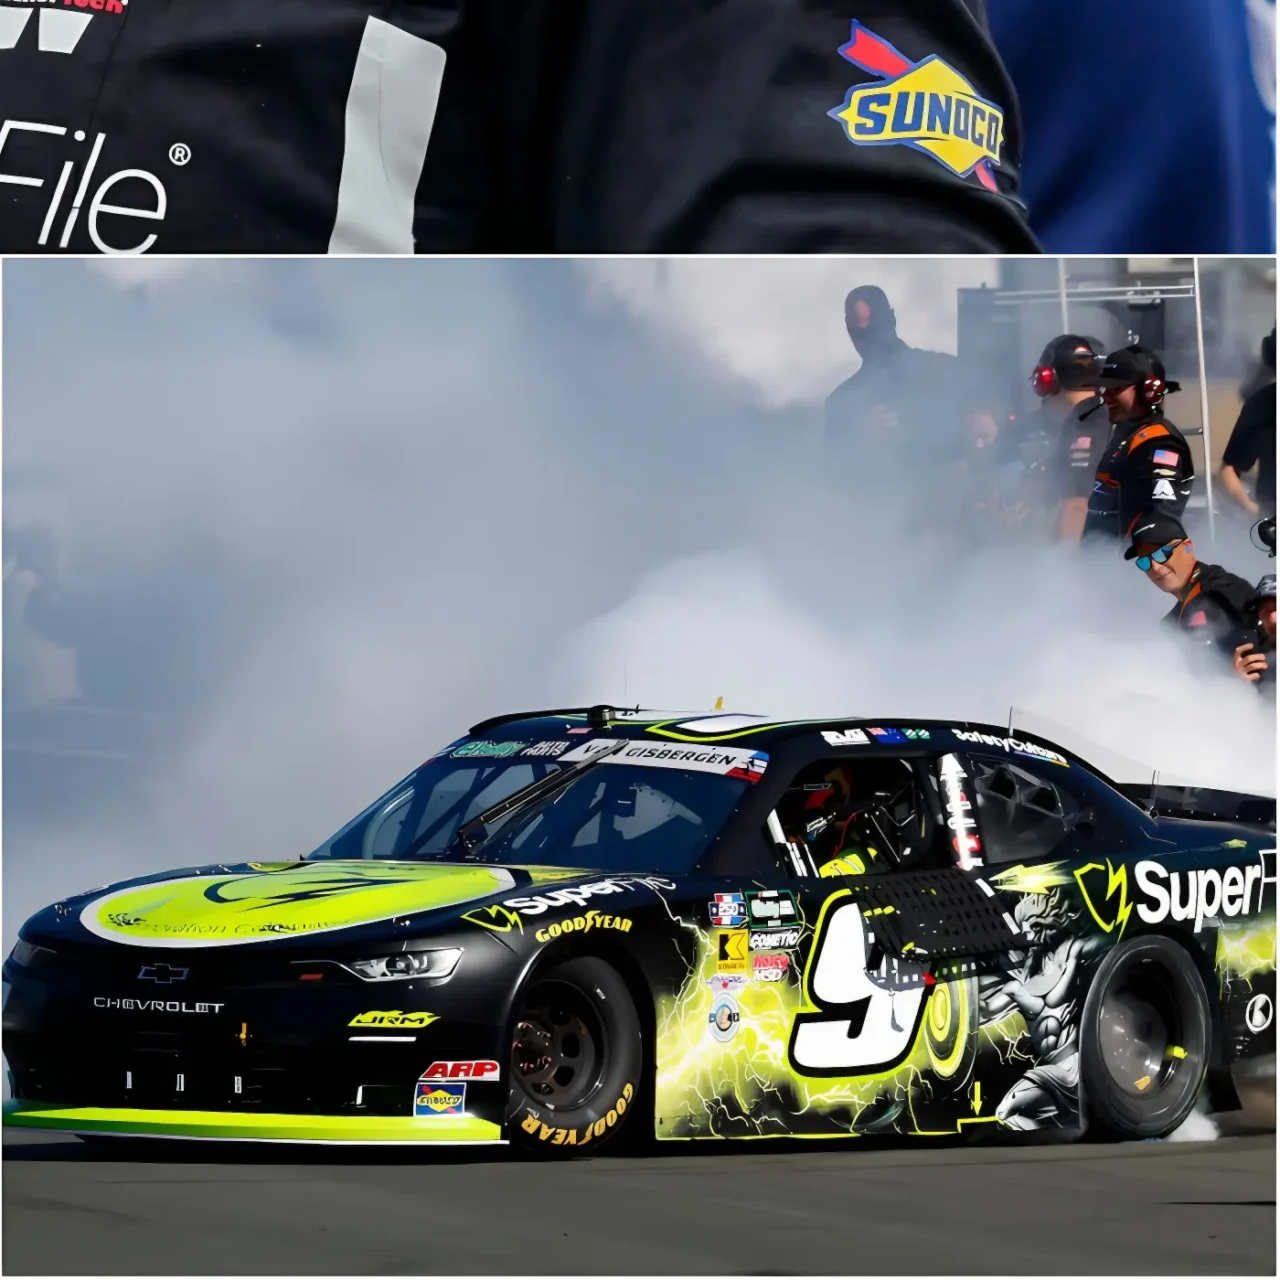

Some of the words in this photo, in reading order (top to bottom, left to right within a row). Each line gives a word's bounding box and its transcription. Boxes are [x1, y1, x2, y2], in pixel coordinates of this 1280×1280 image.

[854, 90, 1000, 157] SUNOCO
[625, 747, 736, 767] GISBERGEN
[535, 910, 633, 943] GOODYEAR
[788, 895, 929, 1072] 9
[93, 997, 225, 1014] CHEVROLET
[355, 1016, 426, 1025] JRM
[422, 1061, 499, 1079] ARP
[521, 1082, 634, 1146] GOODYEAR
